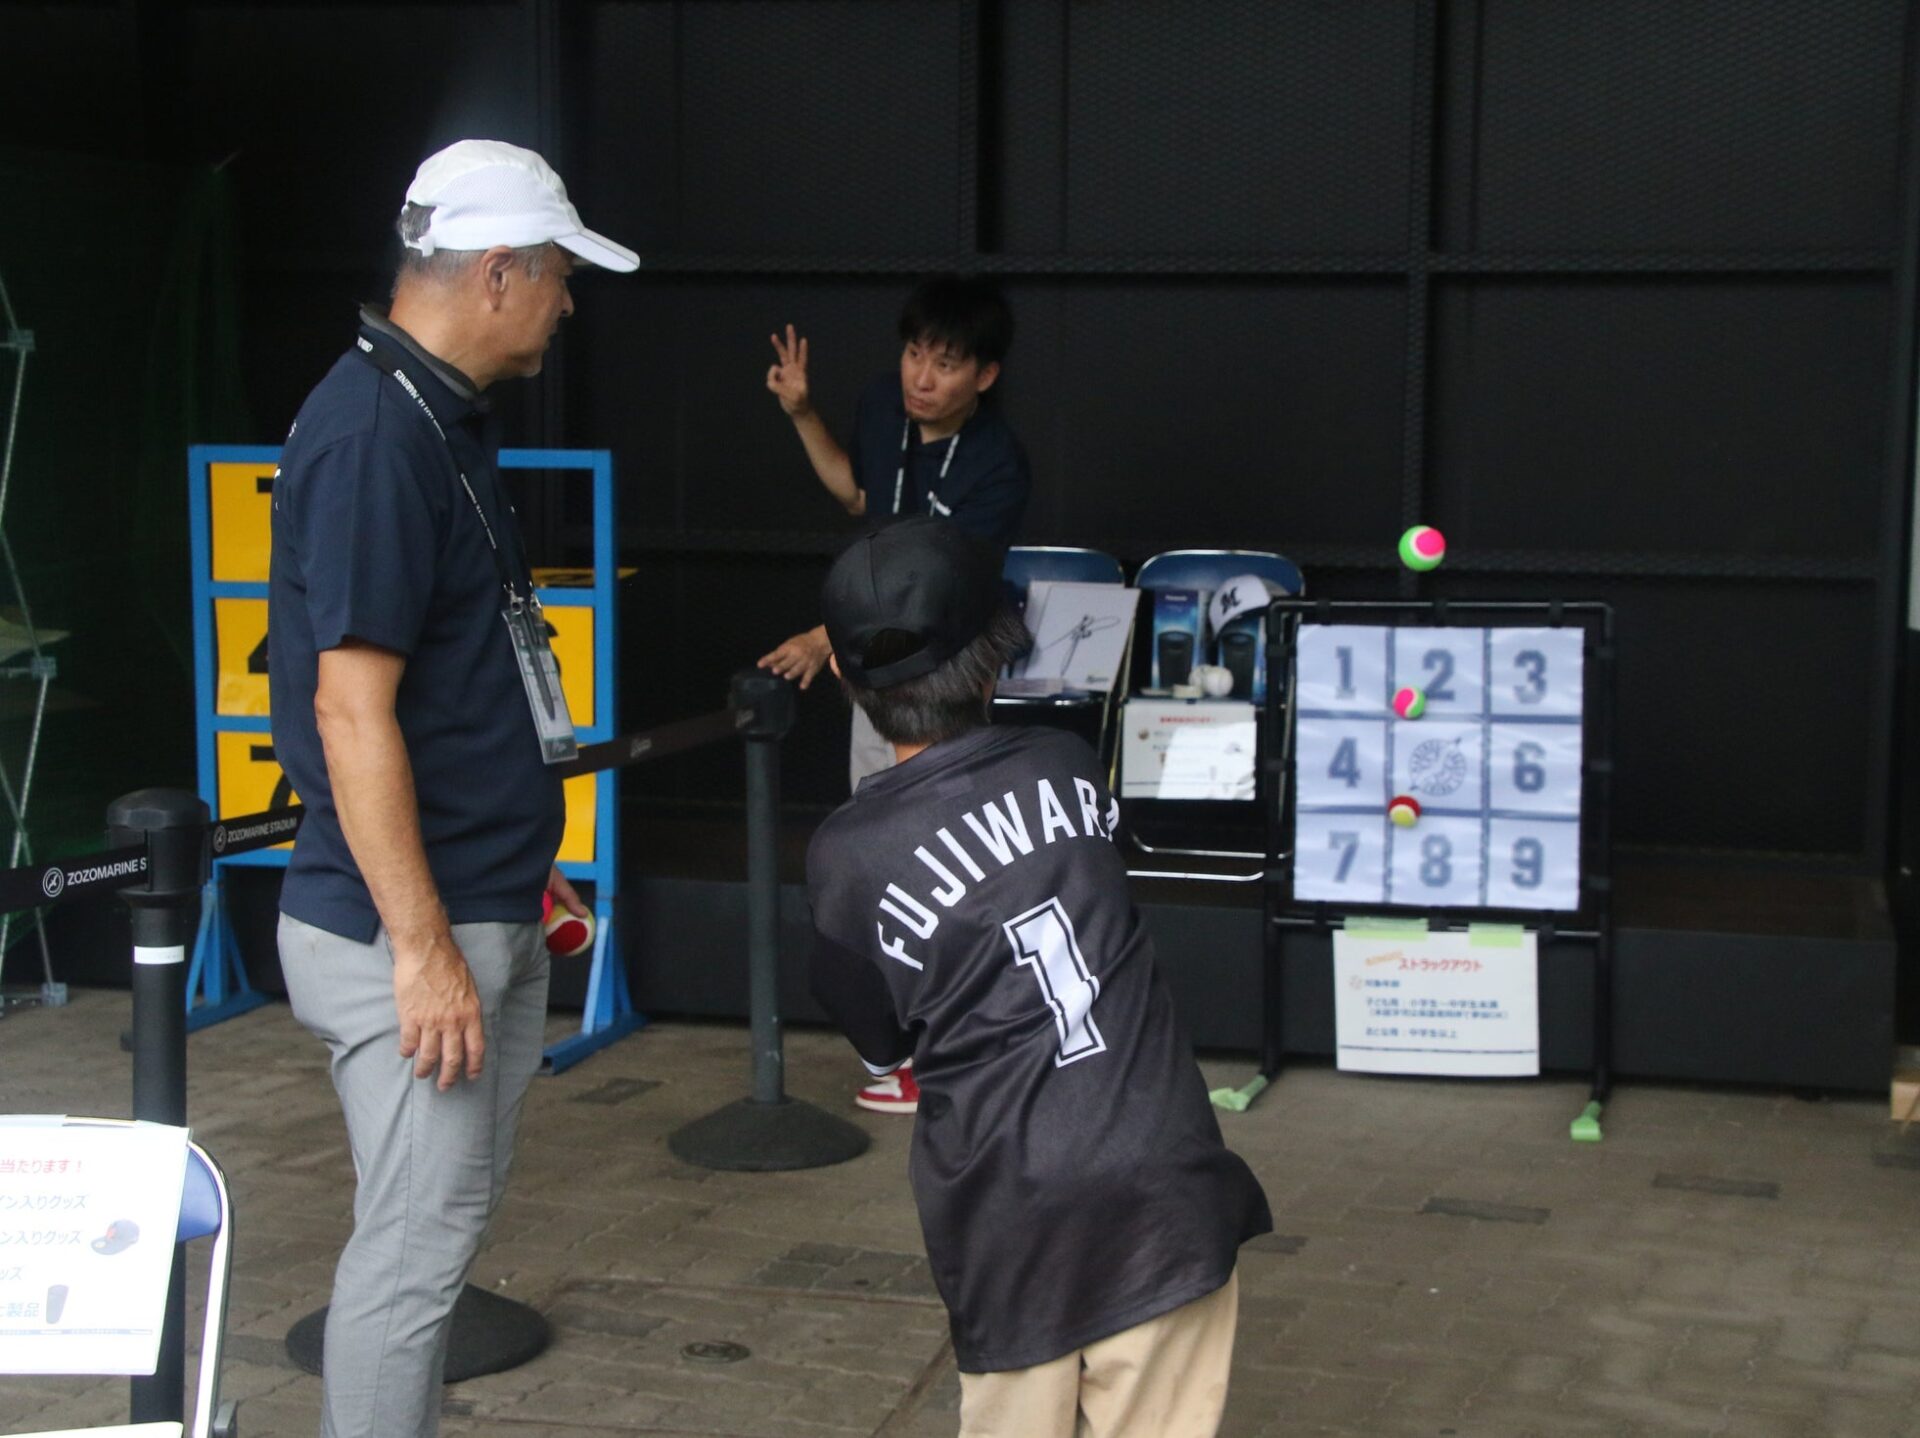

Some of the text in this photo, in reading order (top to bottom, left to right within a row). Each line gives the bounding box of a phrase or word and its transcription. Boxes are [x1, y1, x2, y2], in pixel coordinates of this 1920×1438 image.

[1335, 646, 1548, 704] 1 2 3
[1328, 737, 1362, 789] 4
[1513, 742, 1546, 793] 6
[228, 816, 297, 843] ZOZOMARINE STADIUM
[67, 858, 139, 886] ZOZOMARINE
[1328, 830, 1544, 889] 7 8 9
[1399, 957, 1483, 972] ストラックアウト
[1003, 896, 1107, 1068] 1
[0, 1159, 82, 1174] 当たります！
[0, 1302, 40, 1318] 製品
